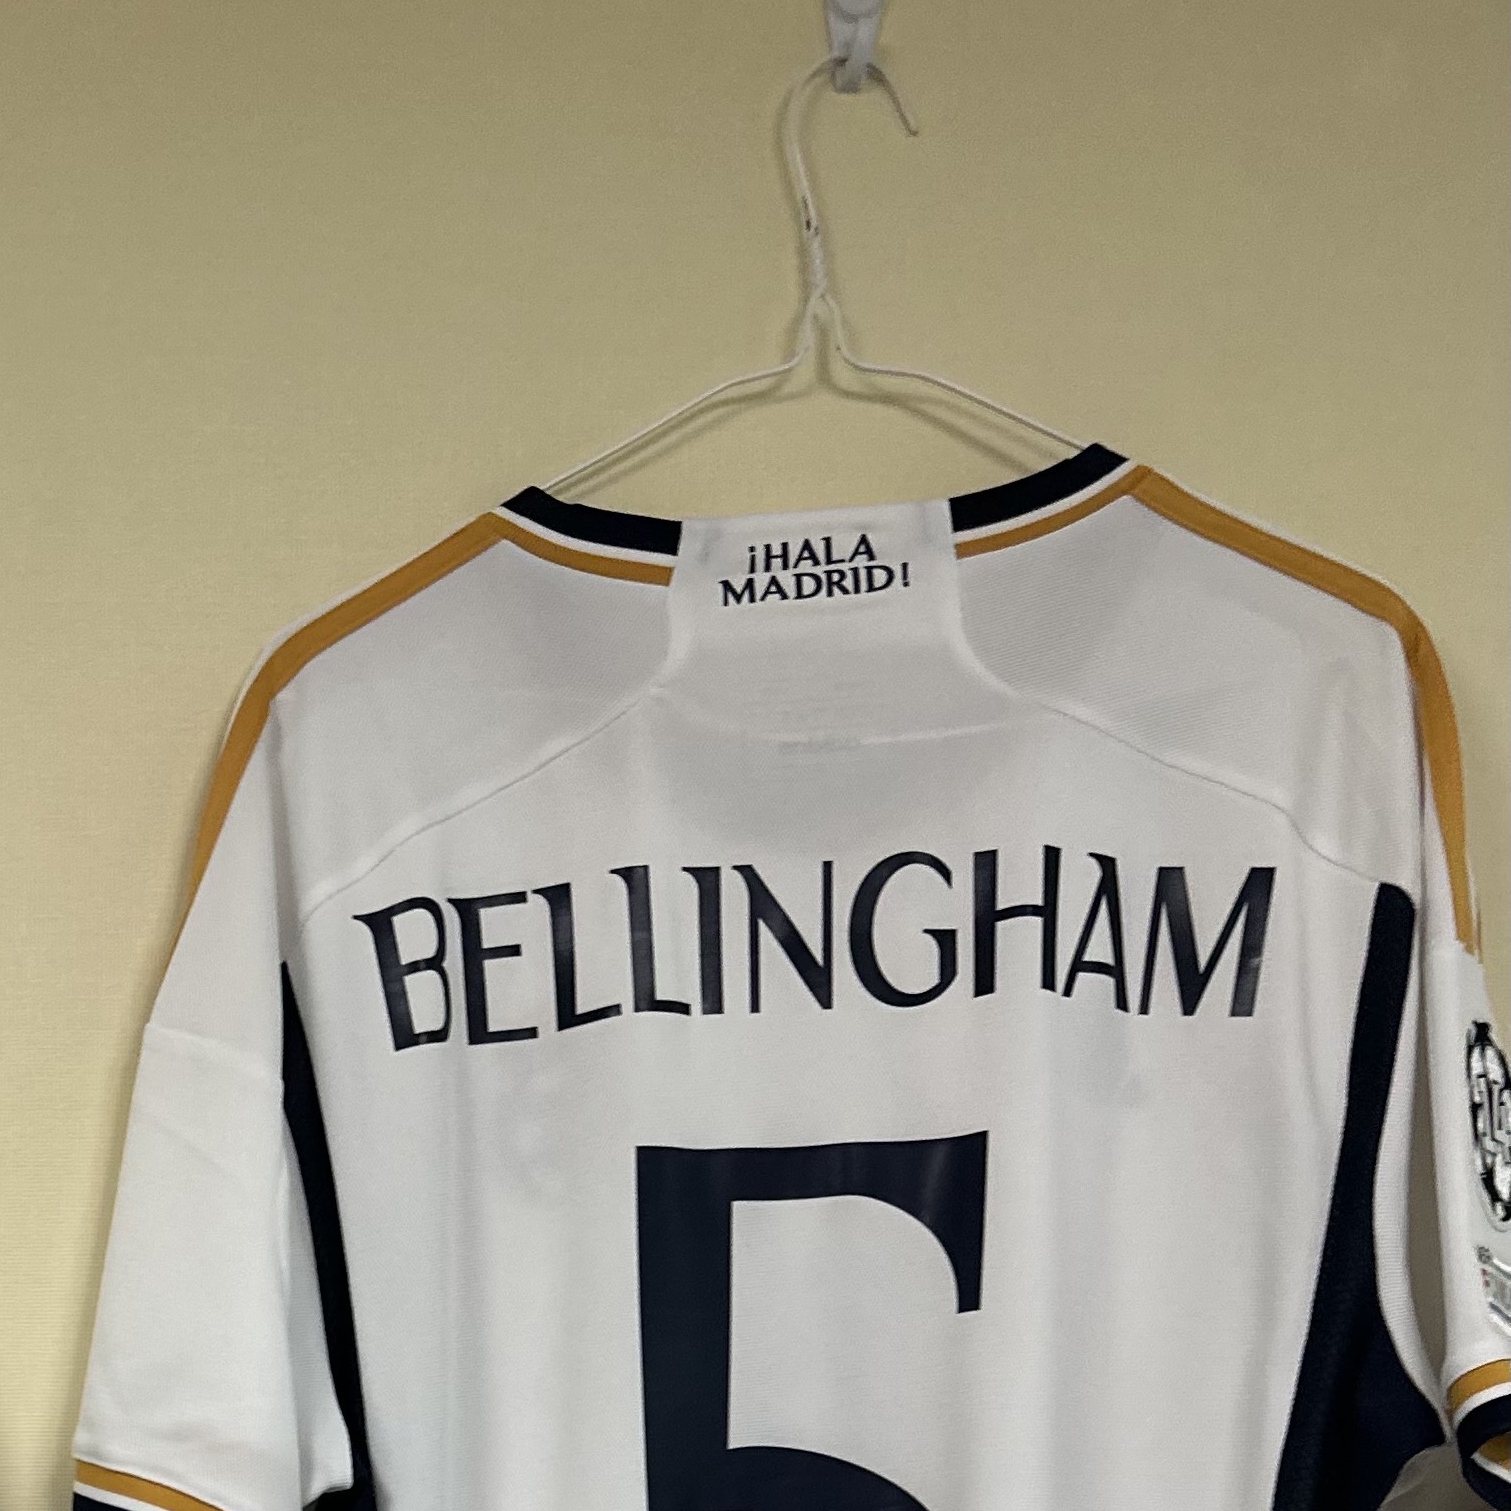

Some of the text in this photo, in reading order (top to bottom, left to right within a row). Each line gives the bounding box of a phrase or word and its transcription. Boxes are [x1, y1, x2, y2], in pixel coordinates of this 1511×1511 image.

[747, 533, 877, 575] ¡HALA
[718, 561, 911, 607] MADRID!
[352, 844, 1277, 1053] BELLINGHAM
